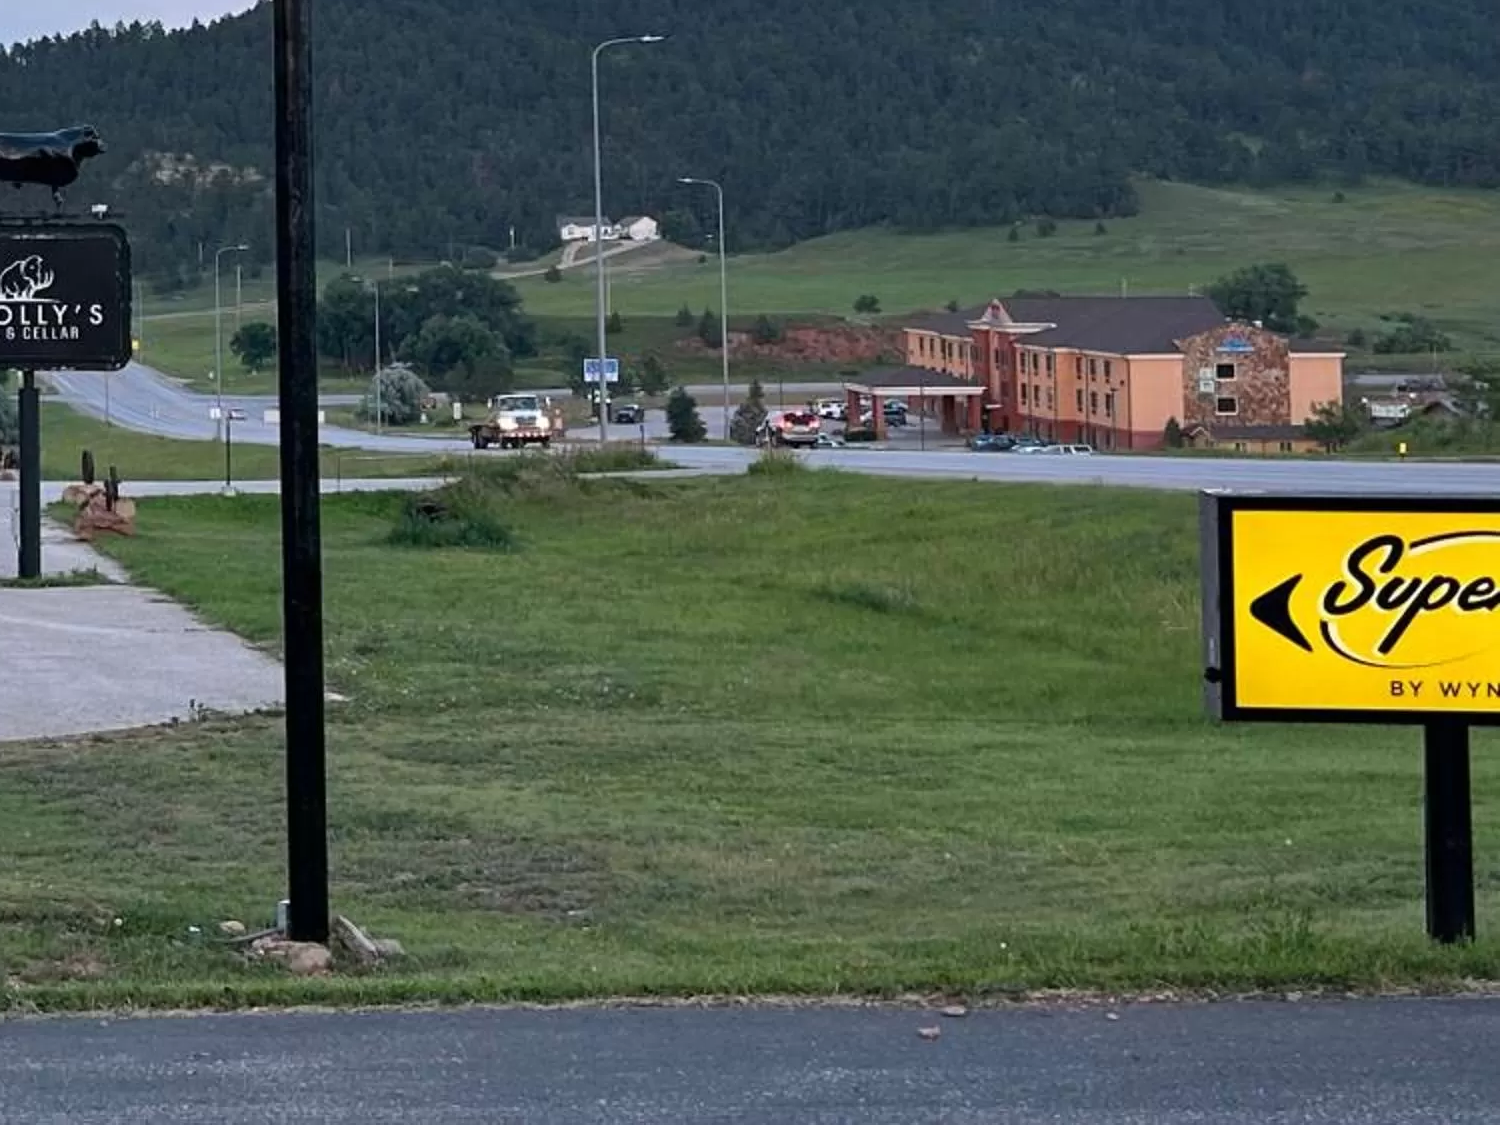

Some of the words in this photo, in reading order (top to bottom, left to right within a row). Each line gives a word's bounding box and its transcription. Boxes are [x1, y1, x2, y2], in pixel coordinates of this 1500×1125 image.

[6, 326, 16, 340] &
[23, 326, 80, 340] CELLAR
[1322, 534, 1500, 655] Supe
[1390, 680, 1423, 697] BY
